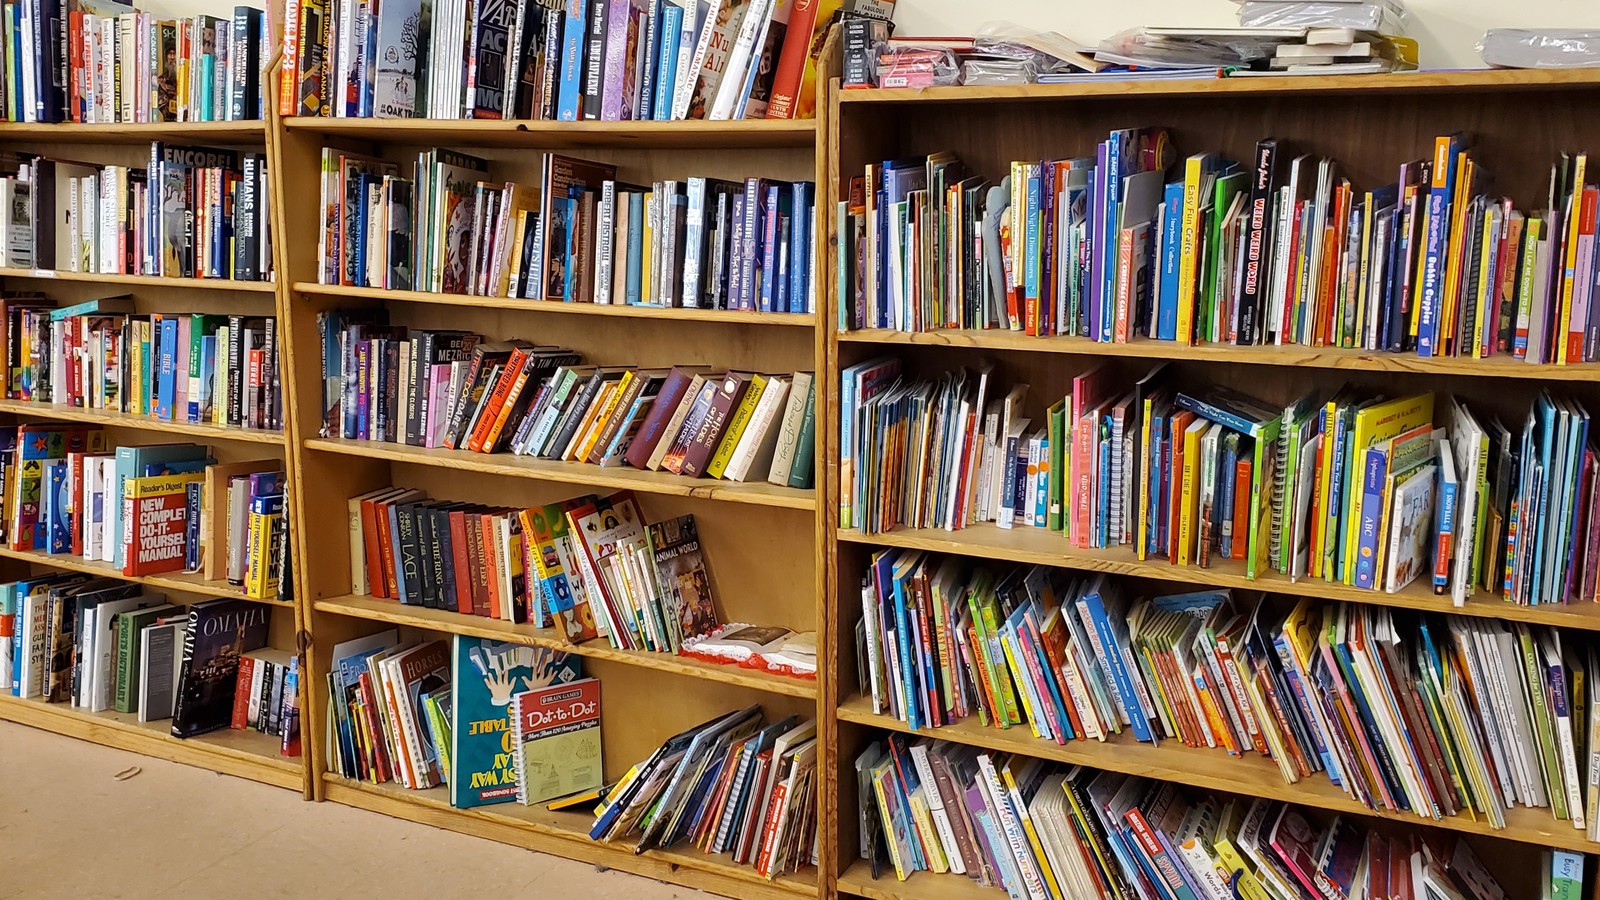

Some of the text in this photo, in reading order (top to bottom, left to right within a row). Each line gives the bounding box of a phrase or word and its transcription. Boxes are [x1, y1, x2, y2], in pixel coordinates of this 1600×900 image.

[516, 5, 524, 28] Game
[861, 4, 886, 15] FABULOUS
[322, 50, 328, 59] OF
[587, 40, 601, 96] UNDUE INFLUENCE
[509, 60, 518, 90] America
[640, 88, 650, 115] SCHULLER
[164, 148, 230, 169] ENCORE!
[1258, 150, 1270, 189] Uncle John's
[1436, 144, 1445, 180] nickelodeon
[245, 159, 254, 209] HUMANS
[747, 182, 755, 201] HARRY
[602, 185, 612, 261] ROBERT JASTROW
[745, 203, 754, 238] TURTLEDOVE
[766, 210, 775, 241] Devotions
[1168, 217, 1177, 244] Storybook
[1246, 198, 1265, 294] WEIRD WEIRD WORLD
[765, 255, 773, 269] Kids
[1426, 257, 1436, 287] Bubble
[1526, 267, 1532, 276] ME
[1119, 265, 1127, 299] CHRISTMAS
[1422, 289, 1434, 324] Guppies
[1522, 297, 1530, 305] TO
[229, 318, 238, 369] PATRICIA CORNWELL
[452, 356, 480, 427] TRIPLE DOG DARE
[495, 355, 521, 398] SHATTERED BONE
[506, 376, 526, 407] SHAKEN
[559, 379, 573, 394] Peru
[622, 377, 640, 402] RIVINGTON
[682, 382, 699, 405] LOVING
[614, 401, 627, 419] STREET
[696, 406, 717, 443] OF HADES
[677, 421, 693, 444] HADES
[684, 418, 701, 448] THE HOUSE
[705, 411, 725, 449] THE HOUSE
[140, 482, 183, 494] Reader's Digest
[1369, 457, 1379, 489] Alphaprints
[1477, 463, 1486, 487] Better!
[140, 497, 164, 511] NEW
[1444, 494, 1453, 524] SNOWBALL
[140, 524, 169, 537] DO-IT-
[399, 511, 407, 540] CONRAN
[466, 520, 475, 559] POINCIANA
[1364, 516, 1374, 536] ABC
[139, 550, 183, 563] MANUAL
[402, 544, 417, 580] LACE
[432, 540, 441, 559] THE
[475, 532, 487, 564] DOROTHY
[656, 542, 698, 562] ANIMAL WORLD
[434, 561, 443, 584] RING
[183, 611, 199, 661] OMAHA
[204, 608, 265, 637] OMAHA
[971, 634, 989, 686] Counting Critters
[1080, 605, 1096, 633] Jackson
[1091, 634, 1104, 654] Braun
[1099, 656, 1115, 684] Smelled
[1112, 692, 1122, 704] Rat
[1109, 644, 1122, 676] Reading Street
[117, 651, 127, 703] DICTIONARY
[1527, 653, 1539, 682] COOKING
[1534, 691, 1543, 706] TWO
[1552, 672, 1564, 709] Alphaprints
[546, 694, 562, 703] BRAIN
[1138, 682, 1151, 709] LOOK LOOK!
[1133, 712, 1142, 729] PEARSON
[1300, 696, 1324, 747] Storybook Collection
[921, 755, 940, 803] OVERACHIEVERS
[1155, 856, 1184, 888] SPYING
[1560, 858, 1575, 878] Busy
